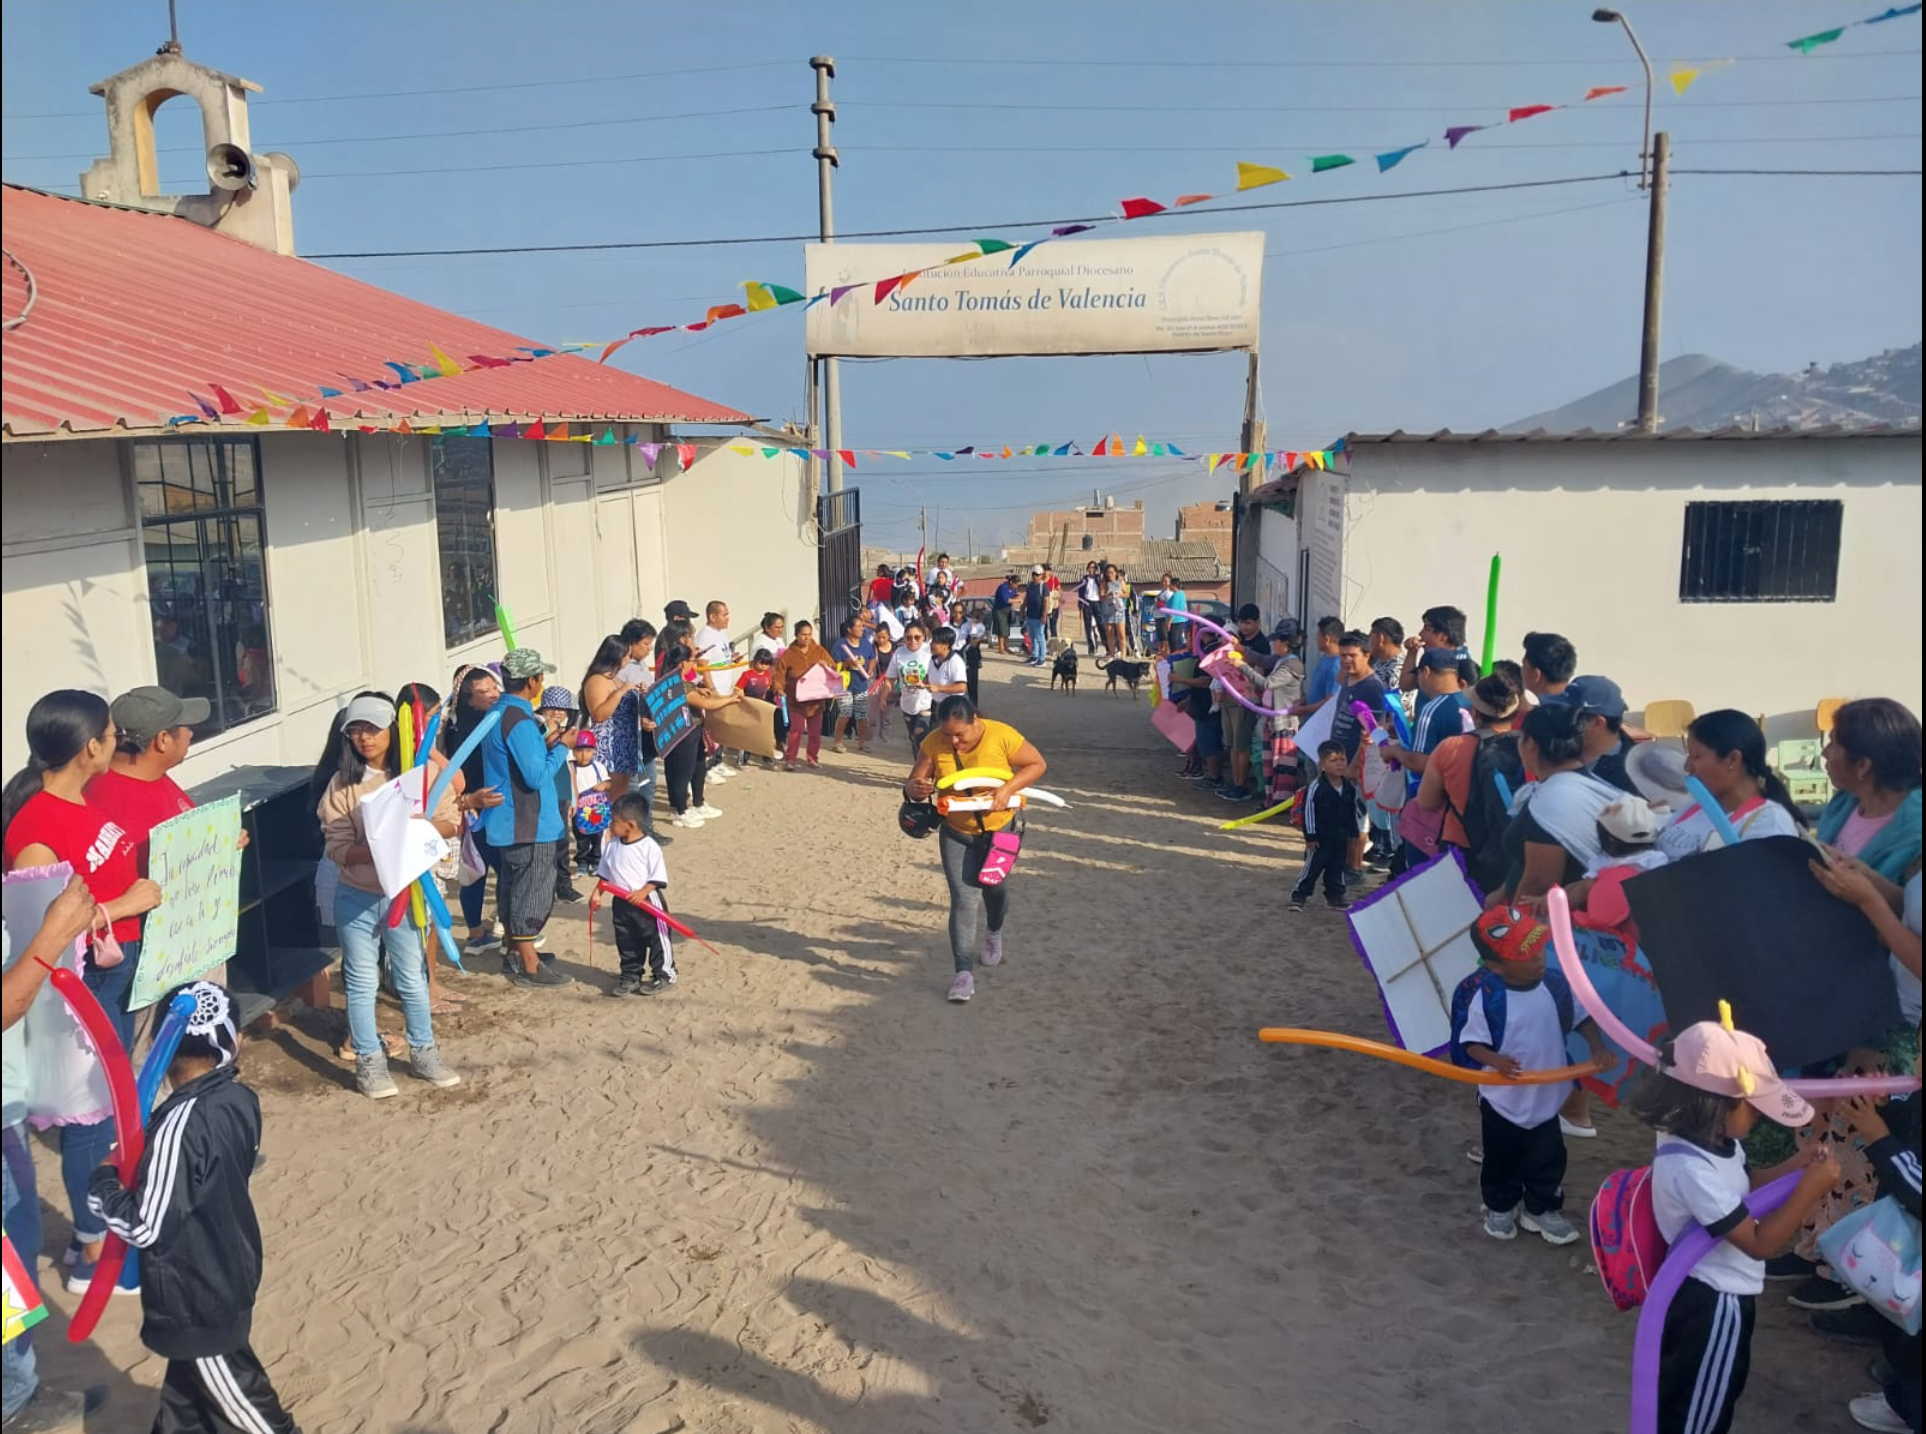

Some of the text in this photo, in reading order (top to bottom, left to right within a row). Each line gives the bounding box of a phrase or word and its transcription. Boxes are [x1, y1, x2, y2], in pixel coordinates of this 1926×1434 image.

[963, 266, 1014, 277] Educativa
[1018, 265, 1074, 279] Parroquial
[1077, 265, 1134, 276] Diocesano
[890, 286, 1147, 311] Santo Tomás de Valencia
